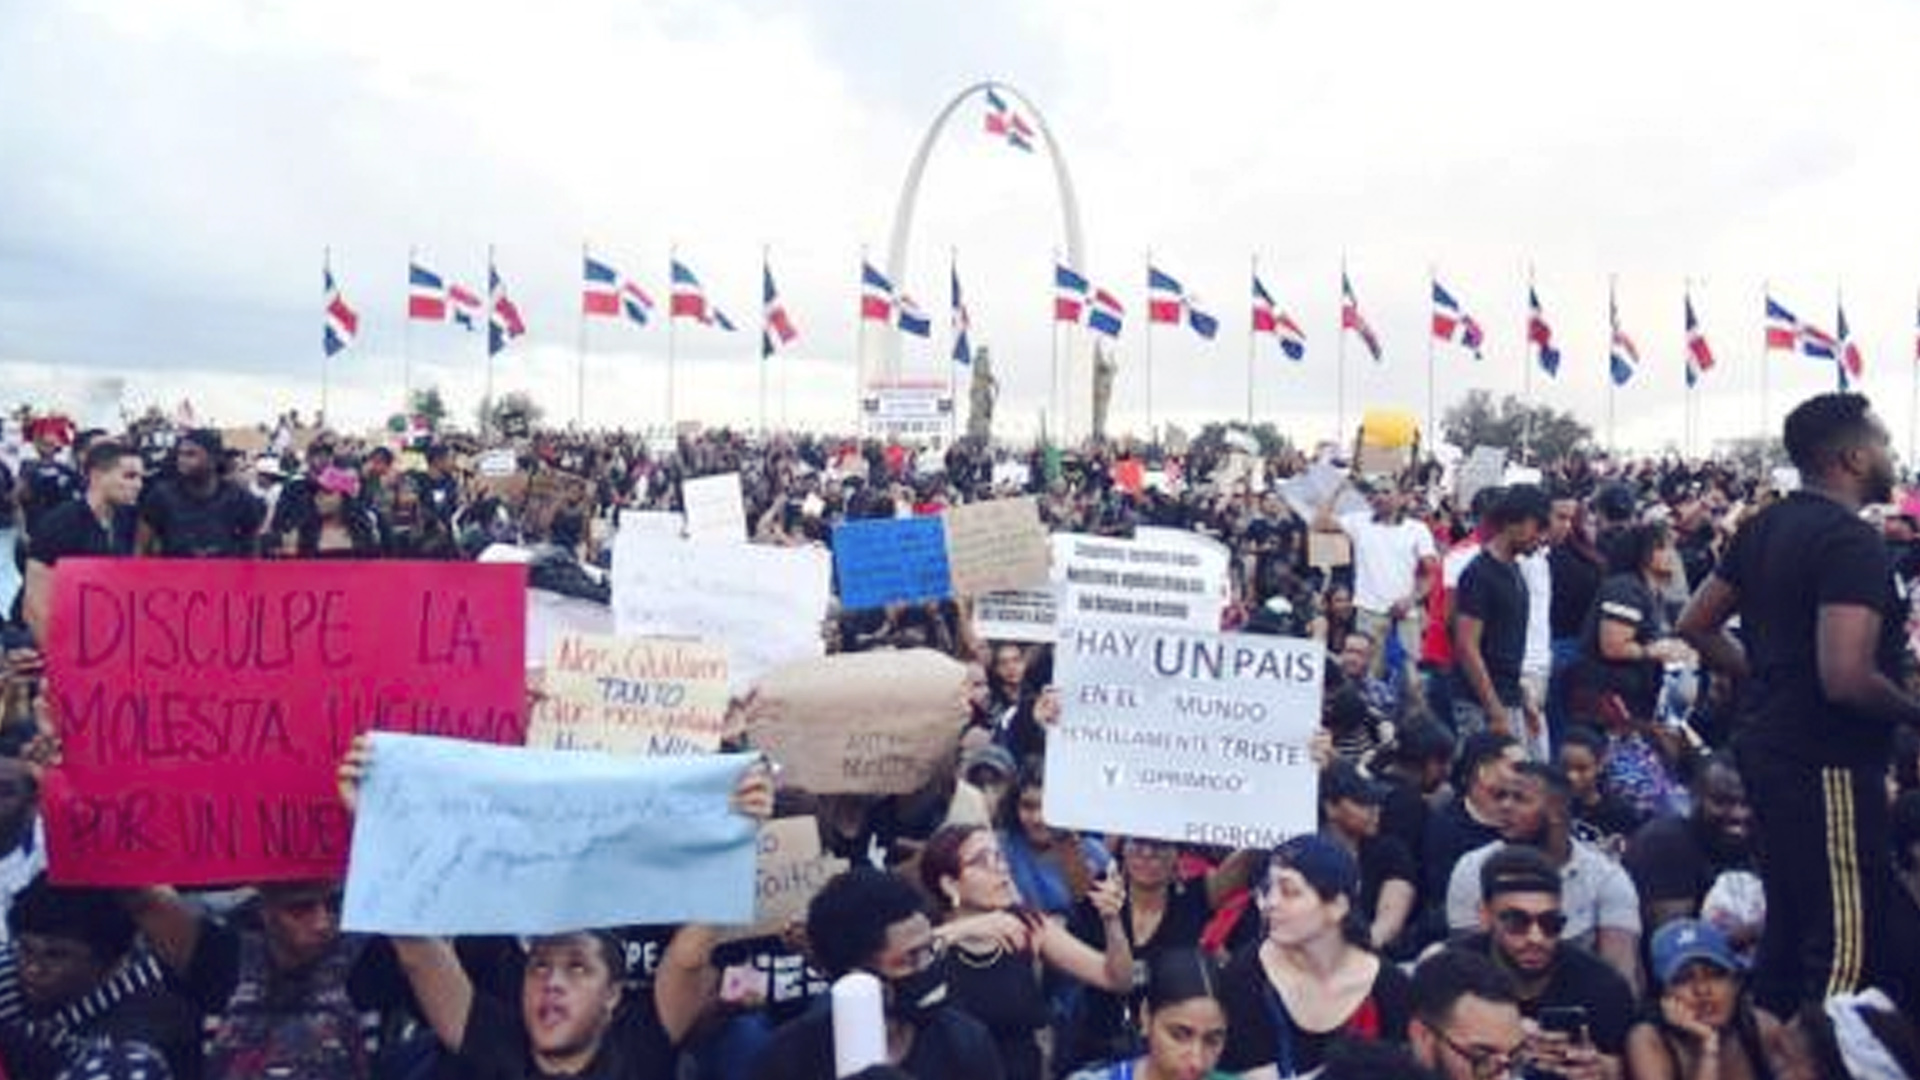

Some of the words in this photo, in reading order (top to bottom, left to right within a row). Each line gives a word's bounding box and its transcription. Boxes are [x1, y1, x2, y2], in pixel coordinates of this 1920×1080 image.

[75, 583, 353, 674] DISCULPE
[416, 590, 484, 666] LA
[1154, 638, 1226, 680] UN
[1234, 649, 1316, 683] PAIS
[597, 677, 685, 709] TANTO
[1176, 696, 1269, 724] MUNDO
[1219, 736, 1304, 767] TRISTE
[1103, 764, 1120, 788] Y
[66, 788, 168, 856] POR
[177, 795, 237, 860] UN
